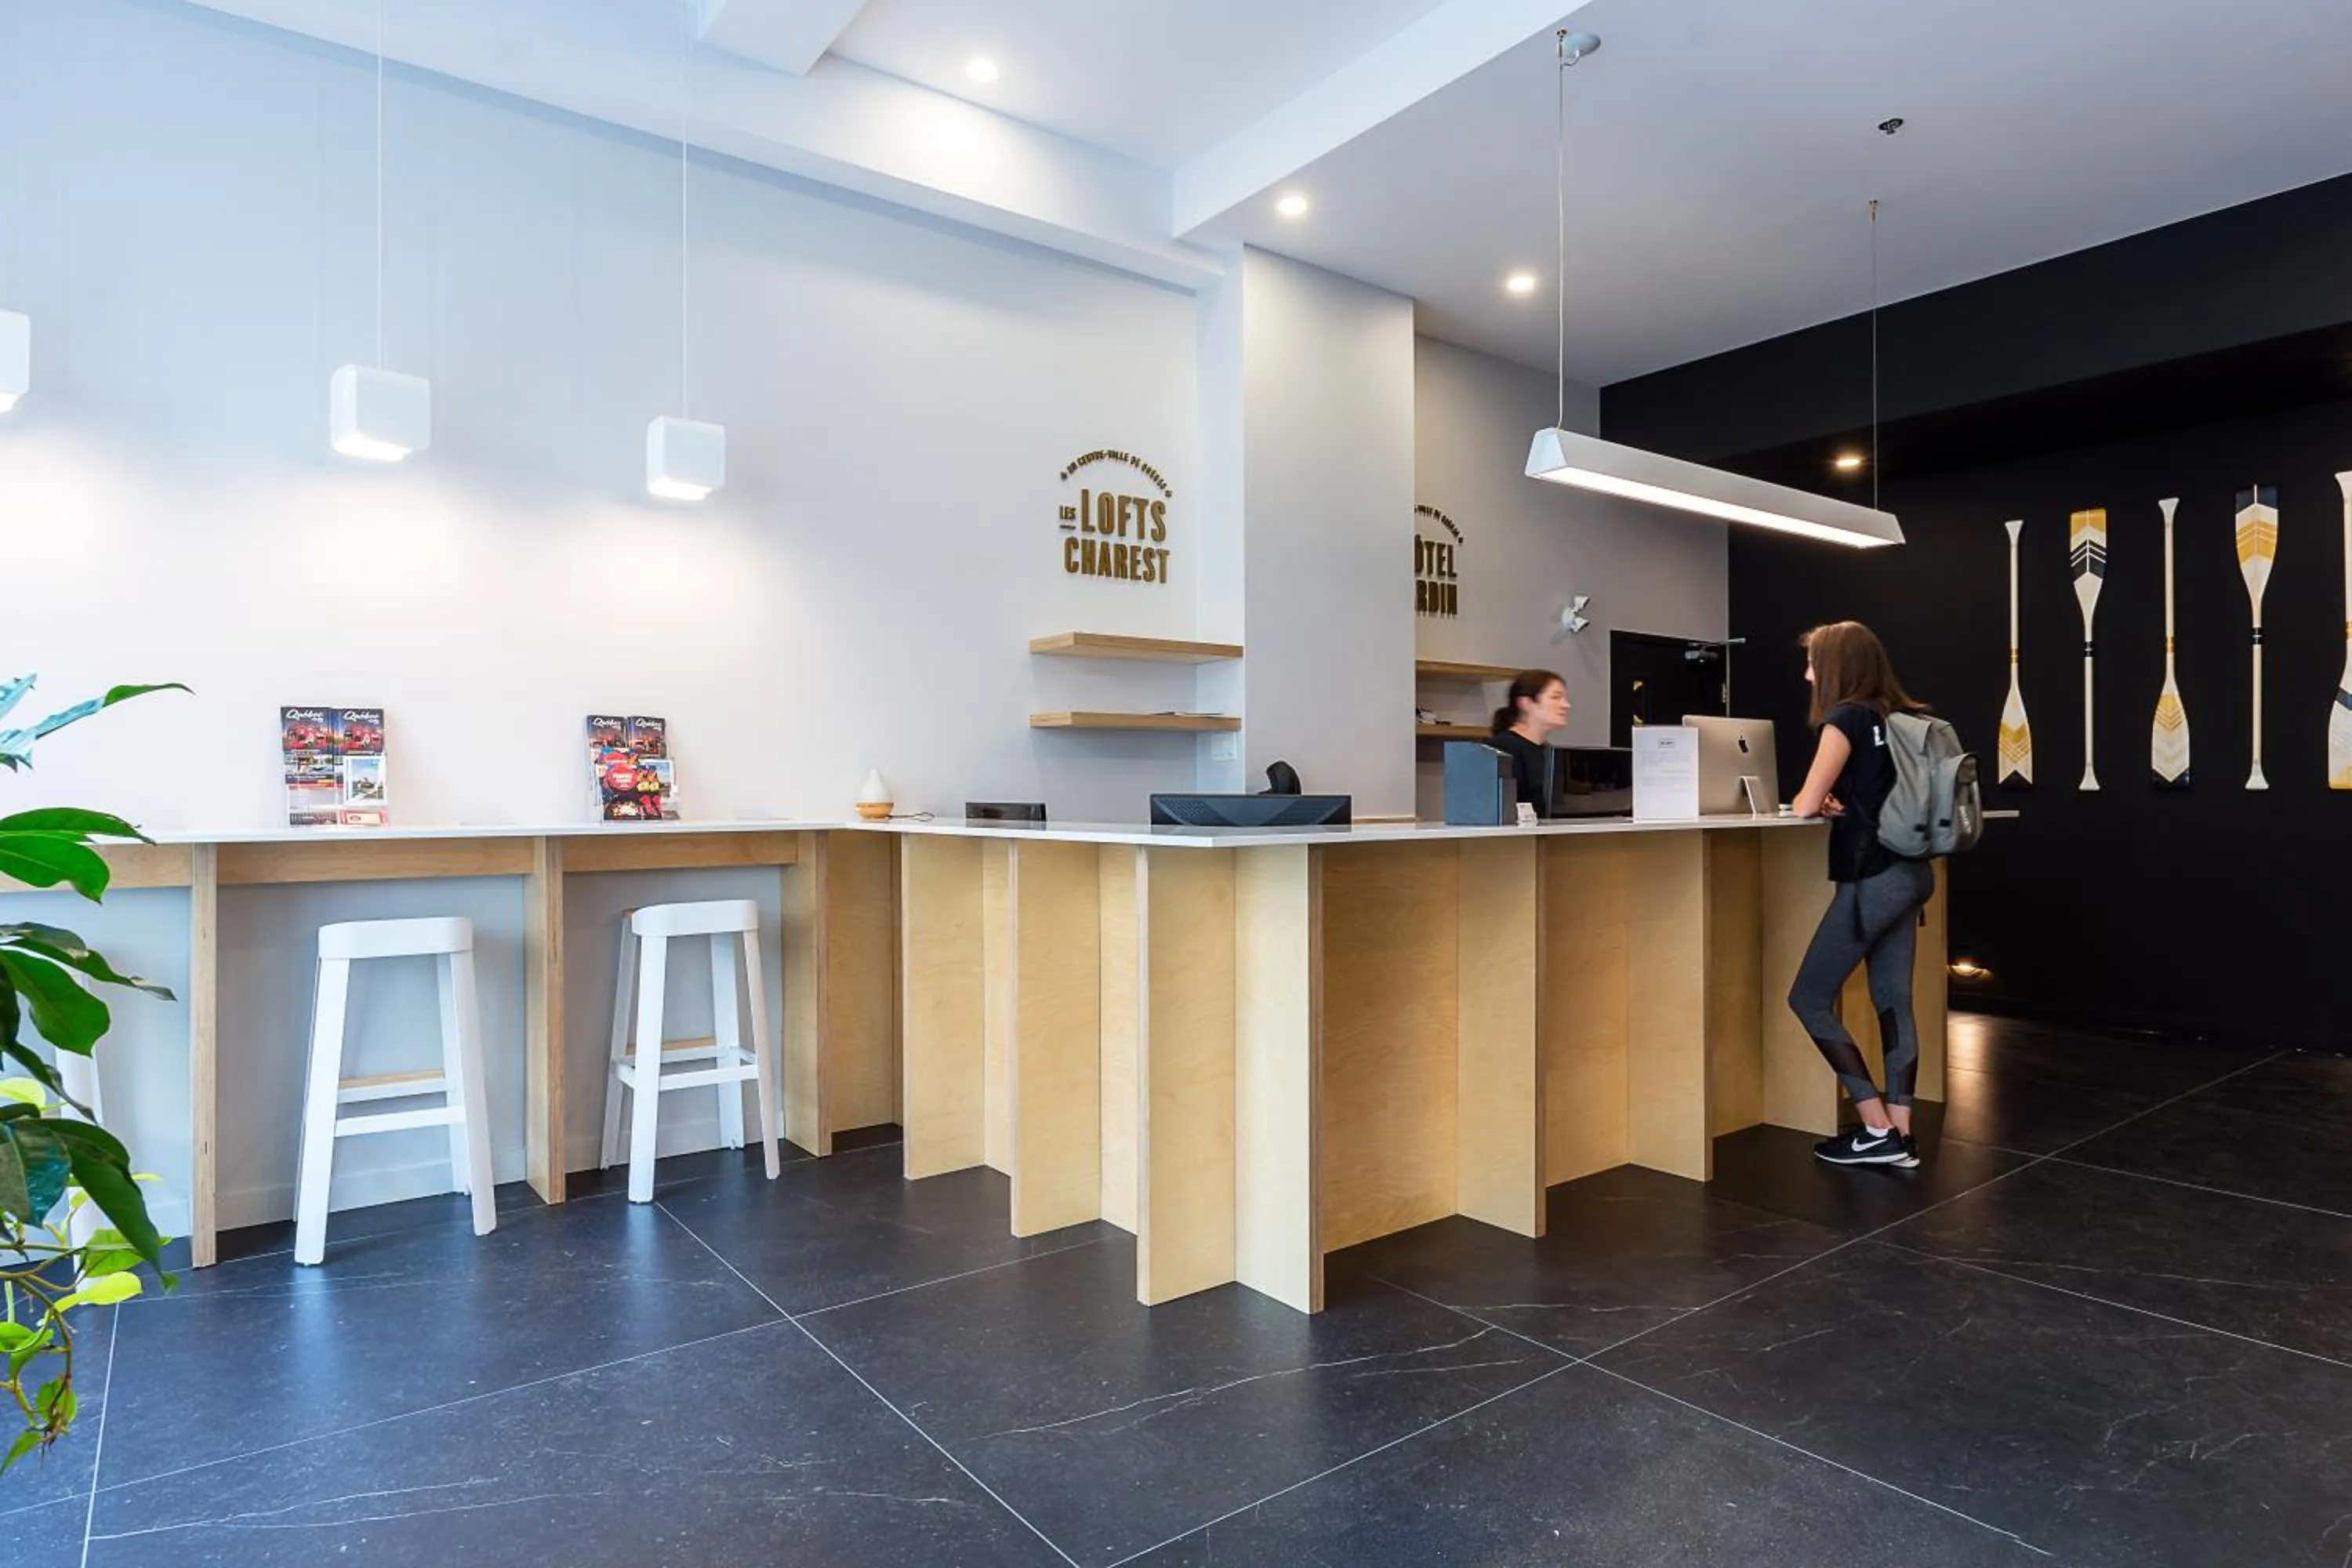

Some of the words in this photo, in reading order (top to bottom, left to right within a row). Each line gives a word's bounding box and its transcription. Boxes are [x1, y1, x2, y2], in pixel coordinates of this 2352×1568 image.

[1077, 449, 1129, 466] CENTRE-VILLE
[1131, 455, 1141, 468] DE
[1059, 505, 1076, 520] LES
[1081, 488, 1167, 542] LOFTS
[1065, 536, 1170, 584] CHAREST
[1414, 534, 1457, 578] ÔTEL
[1415, 580, 1457, 615] RDIN
